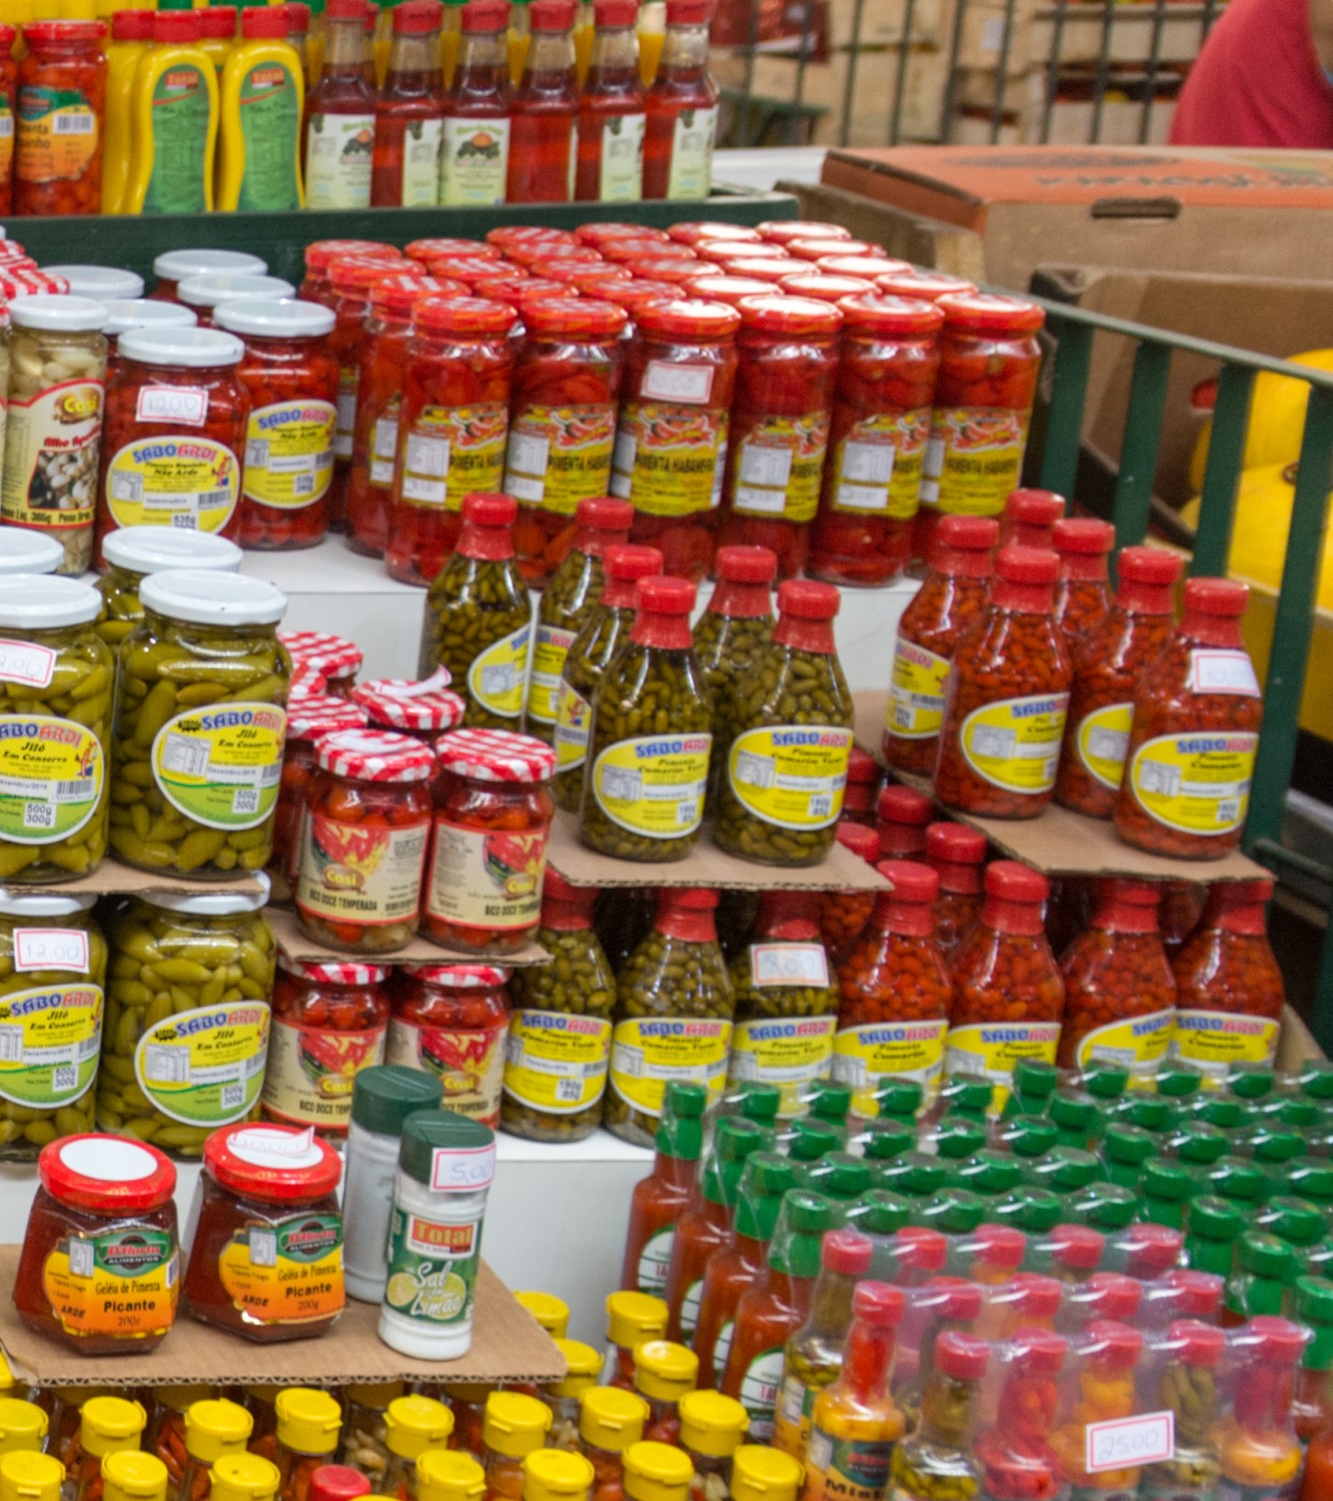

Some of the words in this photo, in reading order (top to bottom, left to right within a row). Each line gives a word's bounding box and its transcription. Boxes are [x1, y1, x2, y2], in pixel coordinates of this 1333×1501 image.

[414, 1223, 473, 1246] Total
[413, 1261, 451, 1290] Sal
[285, 1282, 333, 1299] Picante
[103, 1299, 156, 1314] Picante
